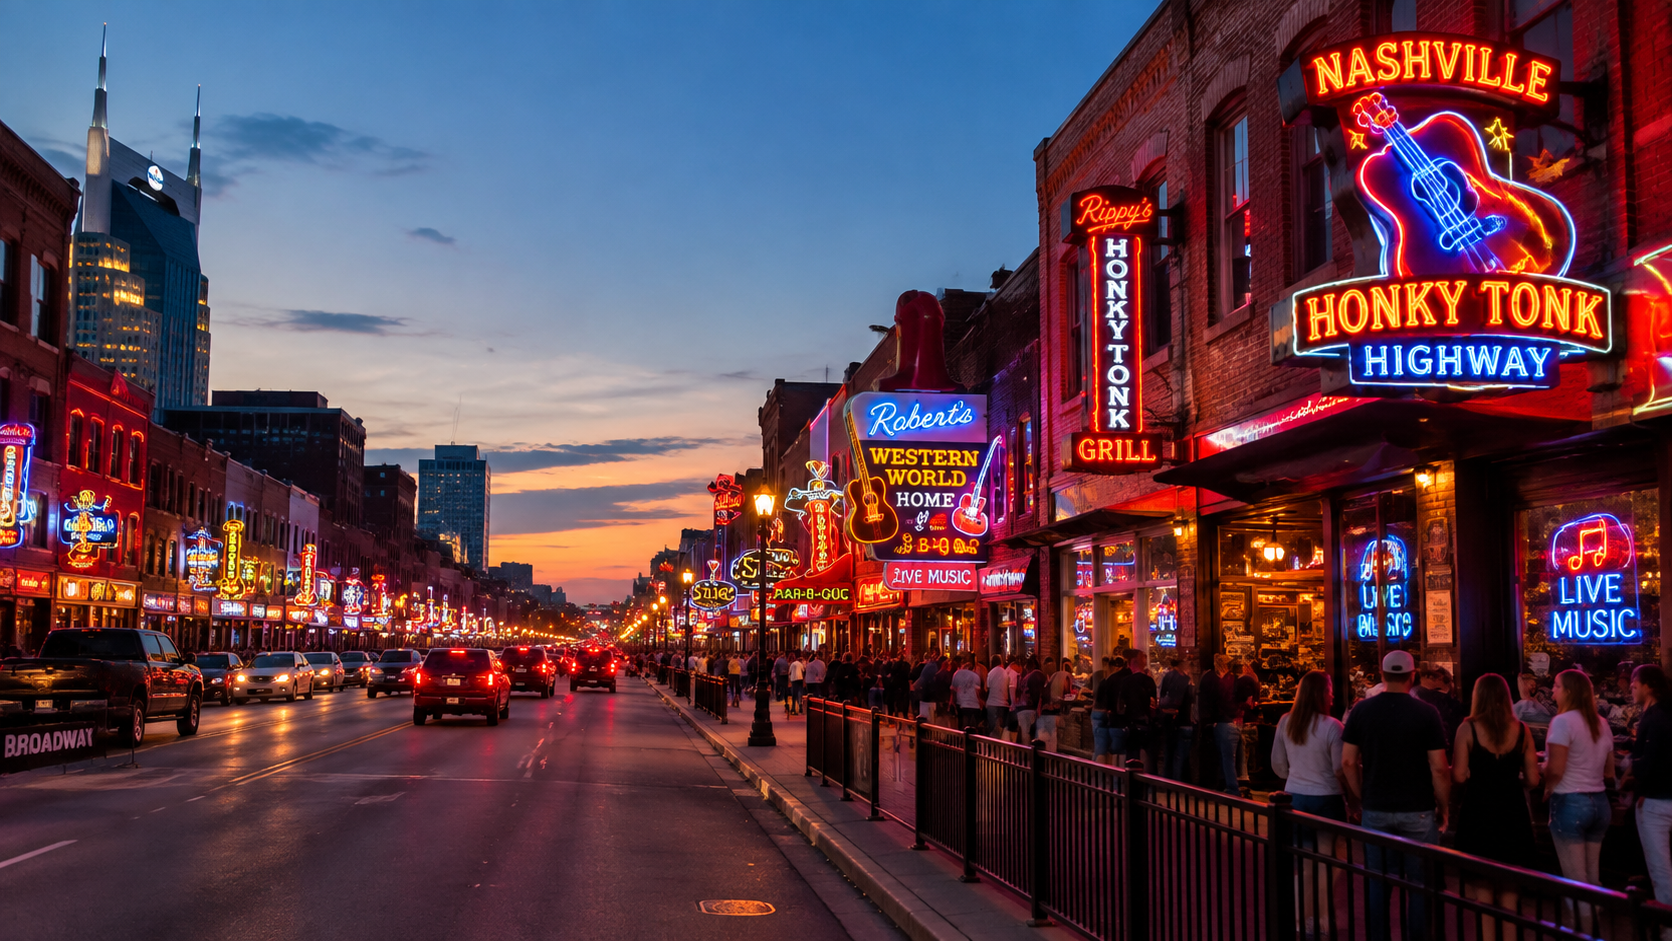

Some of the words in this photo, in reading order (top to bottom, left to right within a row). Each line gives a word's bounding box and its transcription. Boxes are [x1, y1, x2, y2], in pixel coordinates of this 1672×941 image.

[1312, 40, 1552, 102] NASHVILLE
[1076, 194, 1153, 232] Rippy's
[1306, 280, 1467, 341] HONKY
[1480, 281, 1604, 339] TONK
[1363, 344, 1551, 377] HIGHWAY
[868, 400, 973, 437] Robert's
[869, 447, 979, 466] WESTERN
[1078, 438, 1156, 462] GRILL
[885, 469, 967, 487] WORLD
[896, 492, 955, 508] HOME
[891, 567, 922, 585] LIVE
[928, 568, 972, 585] MUSIC
[1560, 573, 1622, 605] LIVE
[1552, 609, 1637, 639] MUSIC
[5, 727, 94, 758] BROADWAY
